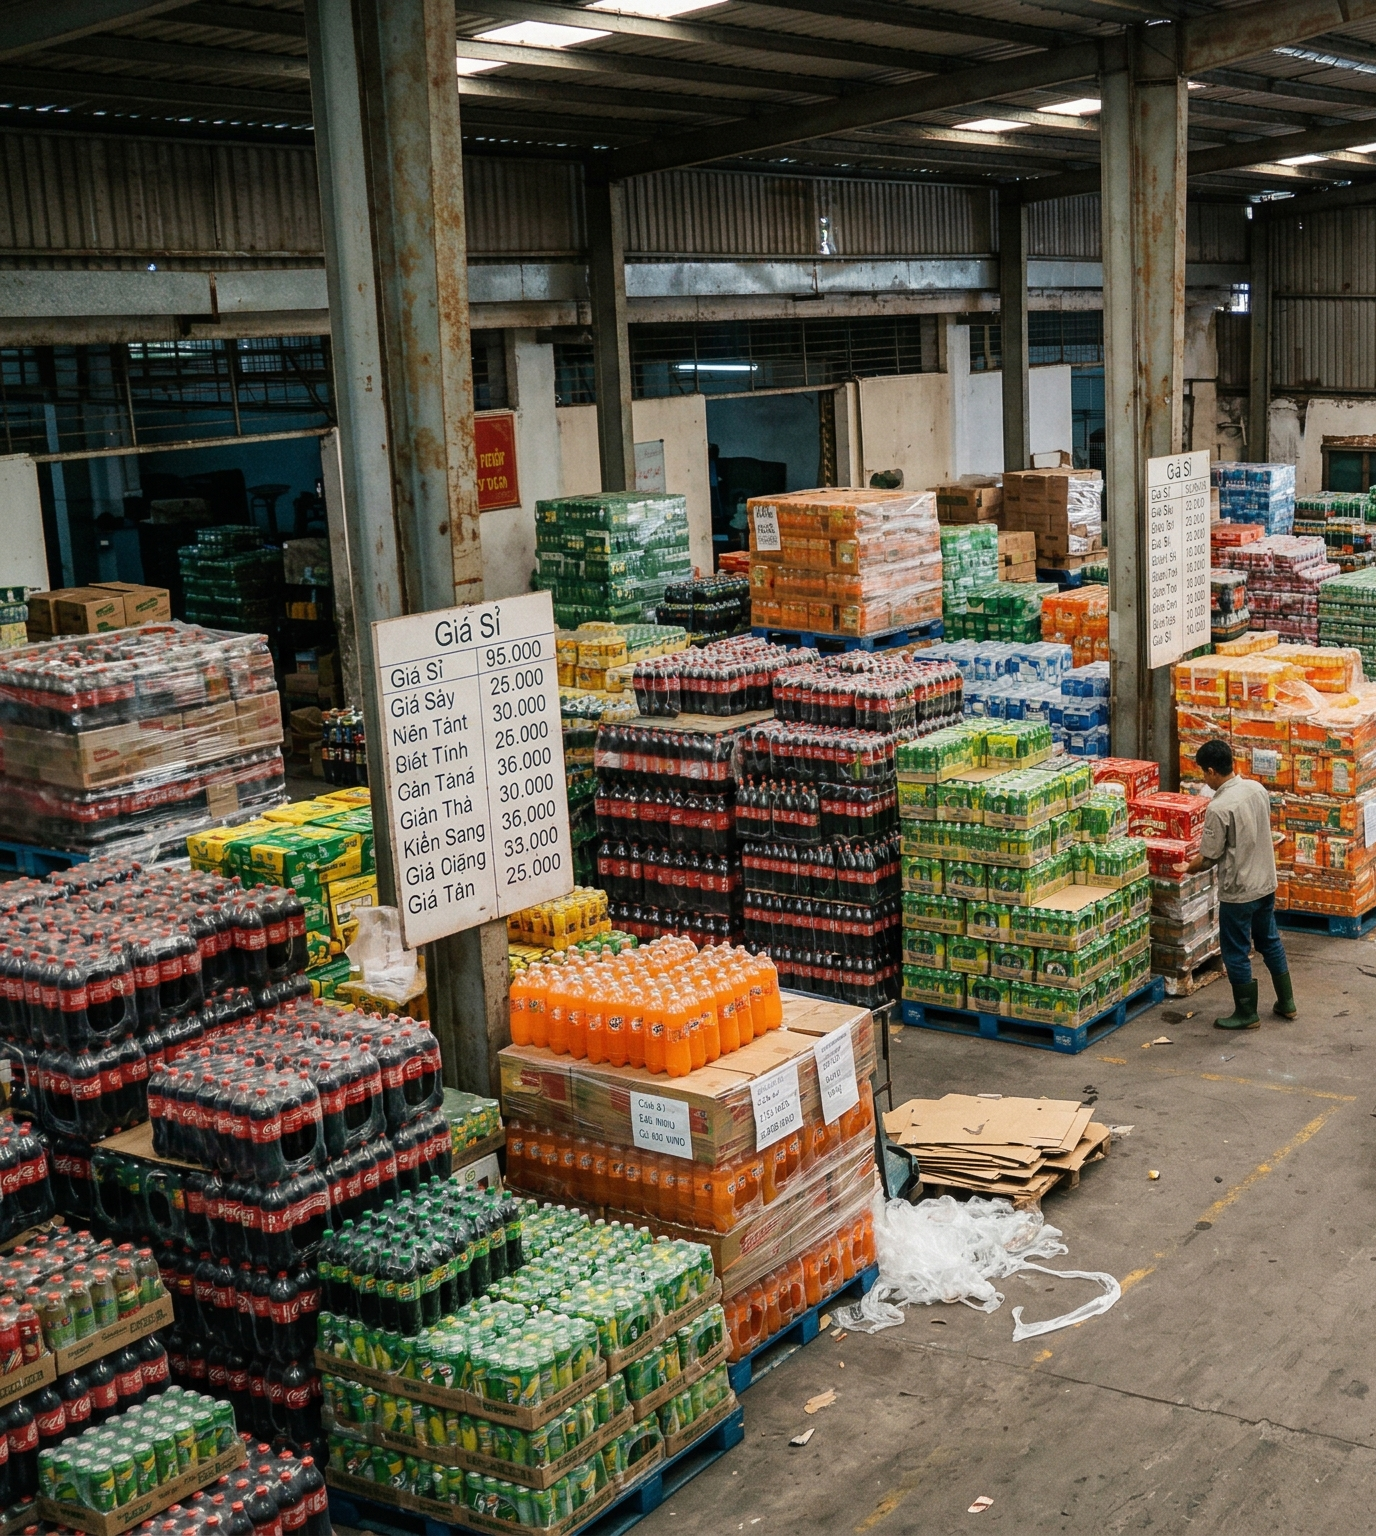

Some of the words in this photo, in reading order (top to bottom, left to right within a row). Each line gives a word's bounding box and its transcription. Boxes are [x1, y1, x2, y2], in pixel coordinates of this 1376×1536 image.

[435, 616, 472, 646] Giá
[480, 606, 501, 638] Sỉ
[391, 666, 421, 688] Giá
[426, 659, 443, 681] Sỉ
[486, 640, 541, 667] 95.000
[391, 694, 420, 717] Giá
[490, 668, 543, 695] 25.000
[493, 694, 546, 722] 30.000
[497, 747, 551, 775] 36.000
[500, 773, 553, 802] 30.000
[445, 824, 486, 847] Sang
[504, 826, 558, 857] 33.000
[408, 889, 438, 914] Giá
[506, 853, 561, 885] 25.000
